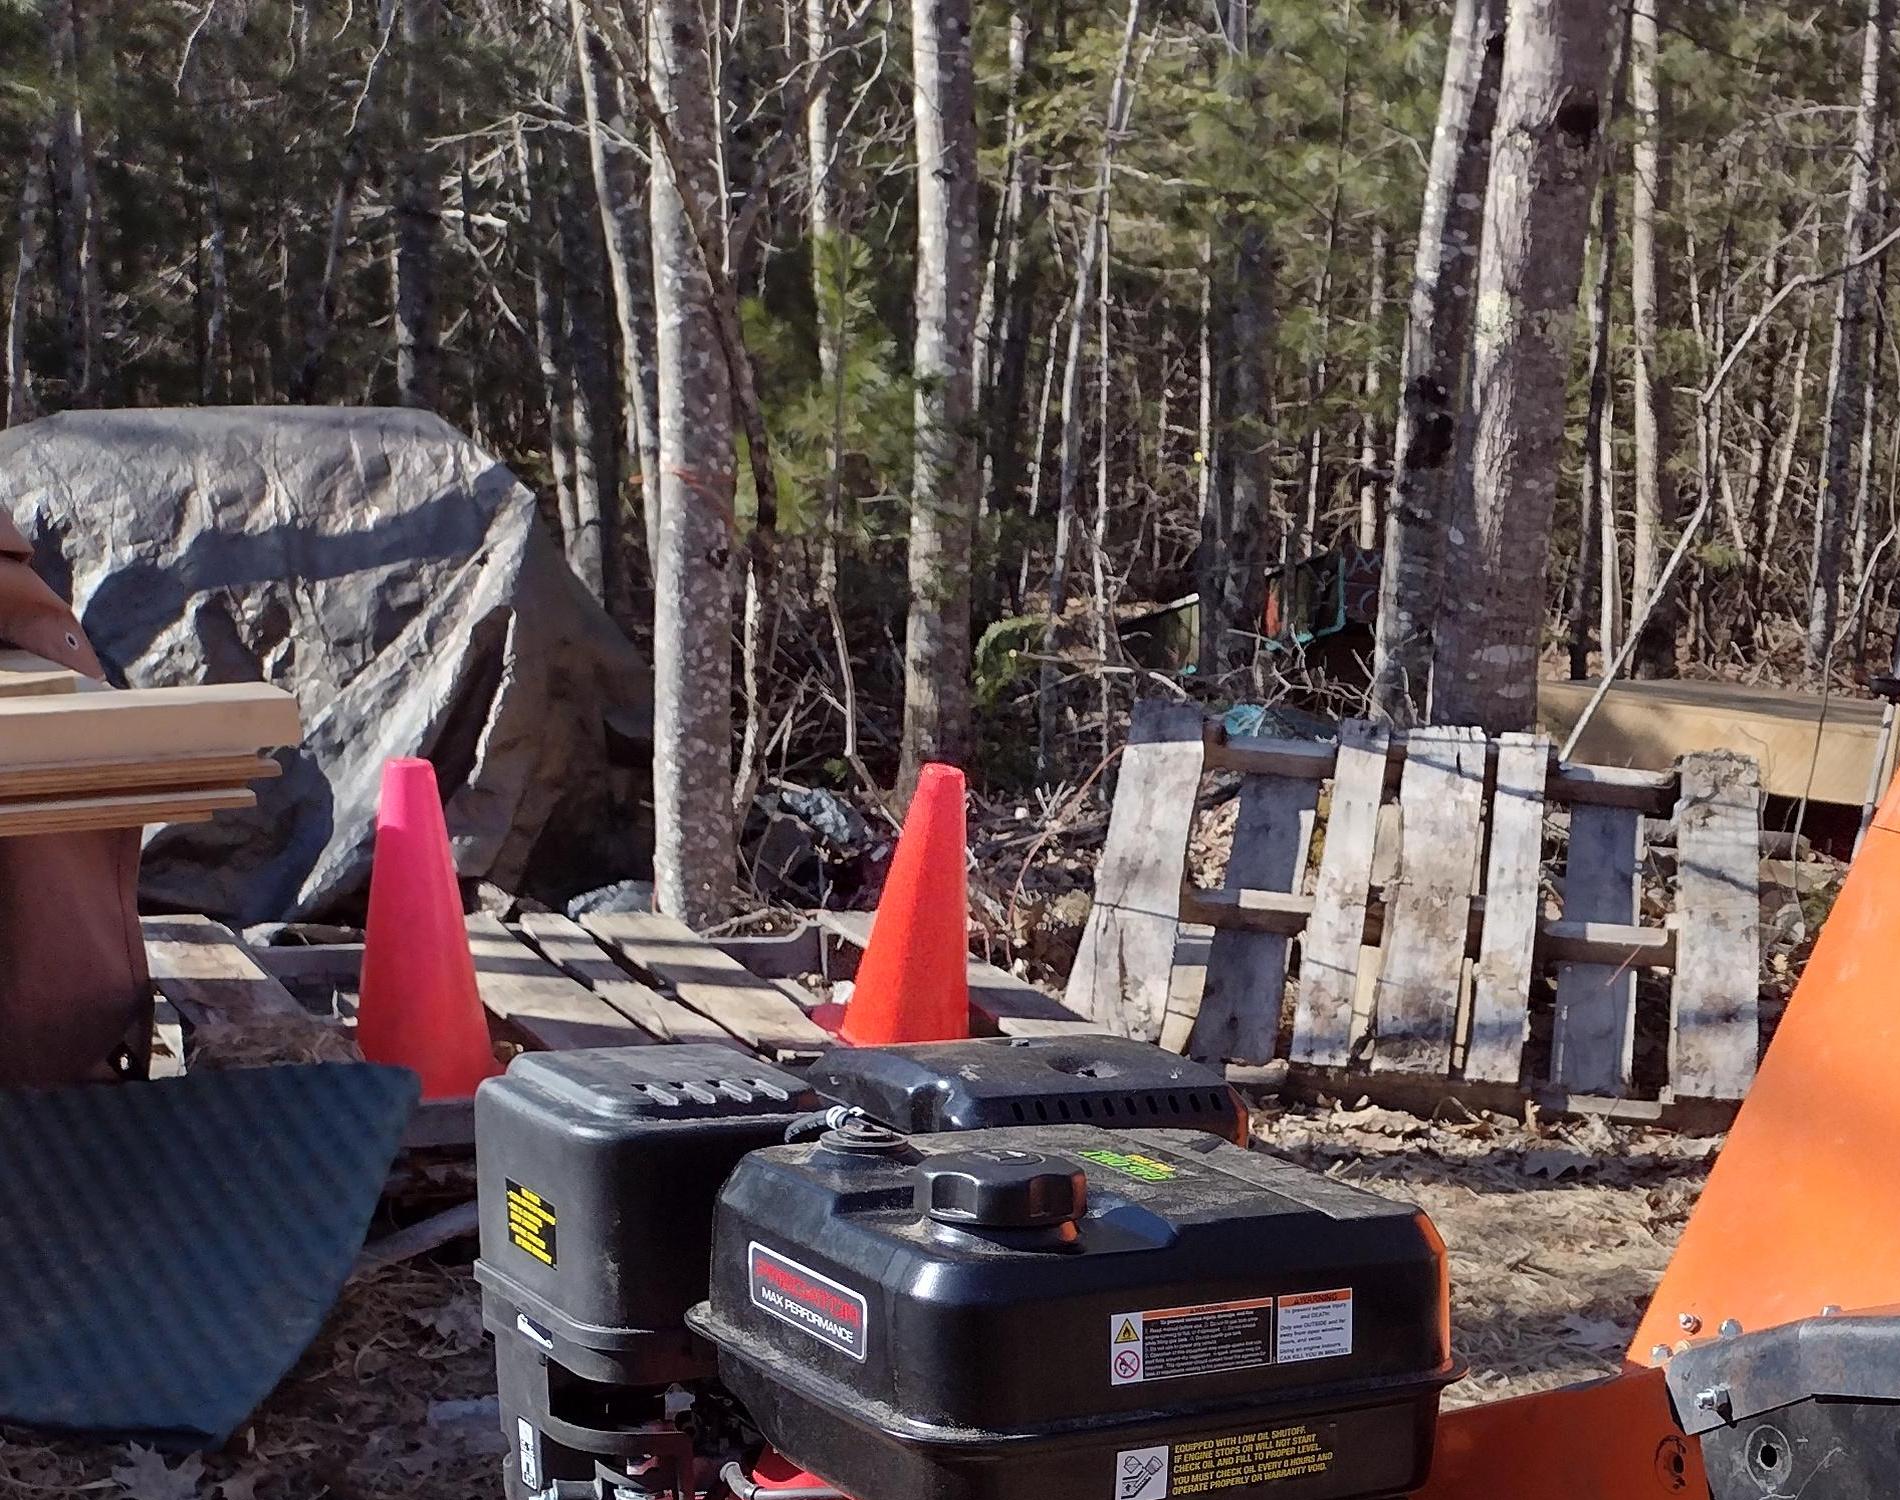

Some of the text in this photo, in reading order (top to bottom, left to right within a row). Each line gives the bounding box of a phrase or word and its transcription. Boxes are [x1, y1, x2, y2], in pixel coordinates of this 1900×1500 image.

[762, 1287, 853, 1343] MAX PERFORMANCE
[1174, 1434, 1316, 1463] IF ENGINE STOPS OR WILL NOT START
[1175, 1440, 1214, 1453] EQUIPPED
[1216, 1436, 1236, 1447] WITH
[1238, 1433, 1255, 1444] LOW
[1258, 1432, 1269, 1440] OIL
[1173, 1477, 1190, 1485] YOU
[1192, 1472, 1214, 1483] MUST
[1216, 1466, 1242, 1478] CHECK
[1244, 1464, 1255, 1473] OIL
[1258, 1460, 1282, 1471] EVERY
[1290, 1454, 1315, 1466] HOURS
[1317, 1452, 1333, 1461] AND
[1174, 1443, 1321, 1473] CHECK OIL AND FILL TO PROPER LEVEL.
[1172, 1482, 1208, 1495] OPERATE
[1210, 1475, 1249, 1490] PROPERLY
[1251, 1473, 1262, 1483] OR
[1264, 1466, 1306, 1481] WARRANTY
